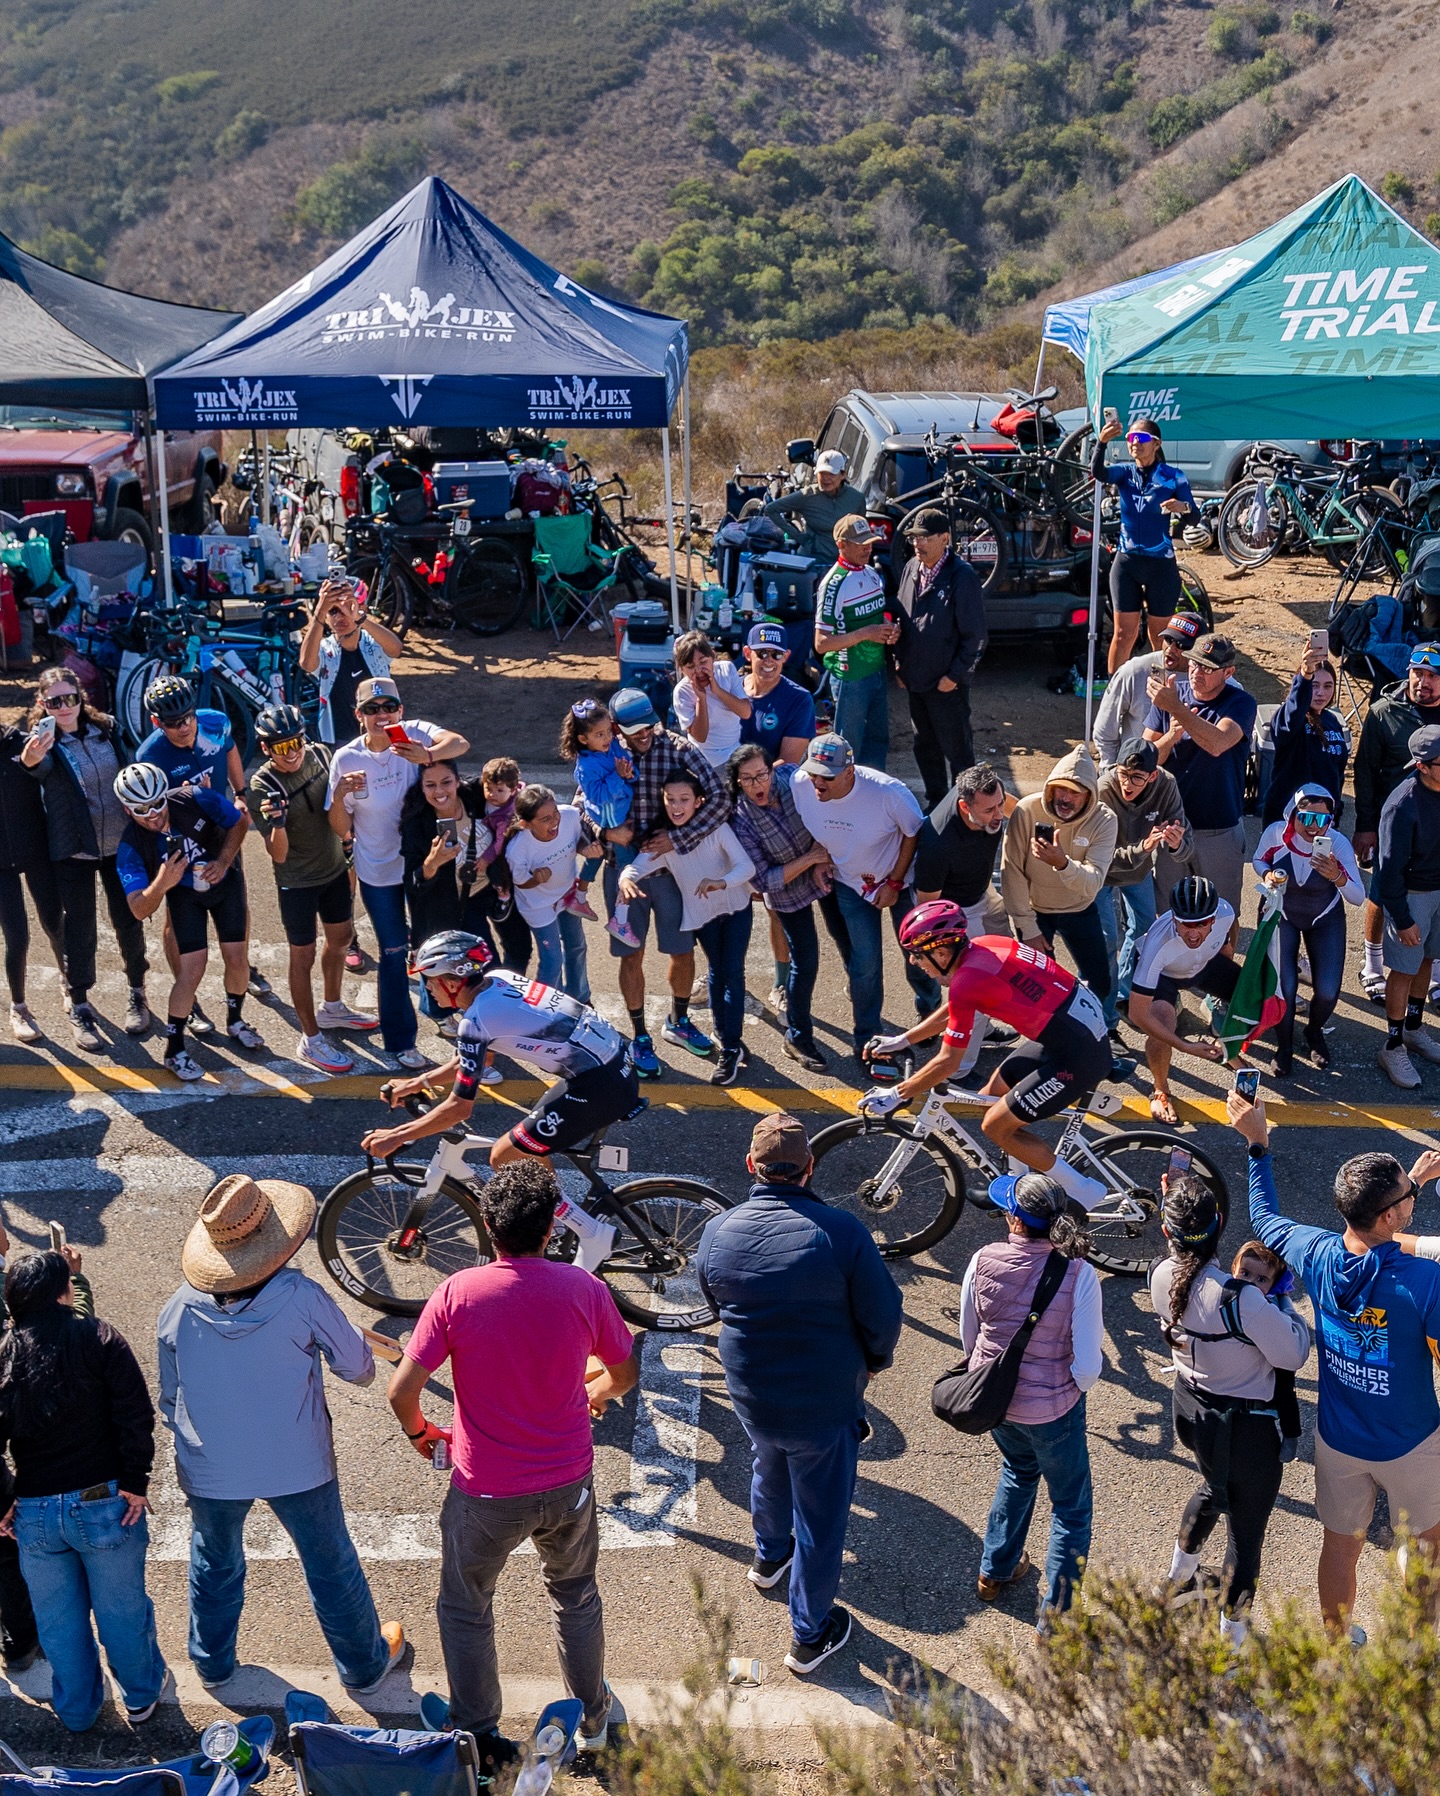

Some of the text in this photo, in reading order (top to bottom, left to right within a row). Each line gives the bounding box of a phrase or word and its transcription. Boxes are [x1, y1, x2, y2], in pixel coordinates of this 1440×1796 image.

[325, 307, 516, 330] TRI JEX
[322, 329, 513, 344] SWIM-BIKE-RUN
[194, 390, 297, 408] TRI JEX
[527, 389, 632, 406] TRI JEX
[197, 412, 298, 422] SWIM-BIKE-RUN
[530, 411, 632, 420] SWIM-BIKE-RUN
[823, 573, 842, 616] MEXICO
[503, 975, 529, 999] UAE
[1009, 971, 1047, 1004] BLAZERS
[1079, 998, 1099, 1018] 3
[1014, 1090, 1038, 1117] CANYON
[1024, 1077, 1066, 1109] BLAZERS
[1098, 1095, 1111, 1109] 3
[535, 1111, 565, 1137] G42
[515, 1128, 544, 1151] Emirates
[614, 1149, 621, 1165] 1
[328, 1258, 366, 1297] ENVE
[656, 1307, 714, 1328] ENVE
[1325, 1348, 1389, 1383] FINISHER
[1368, 1380, 1390, 1396] 25
